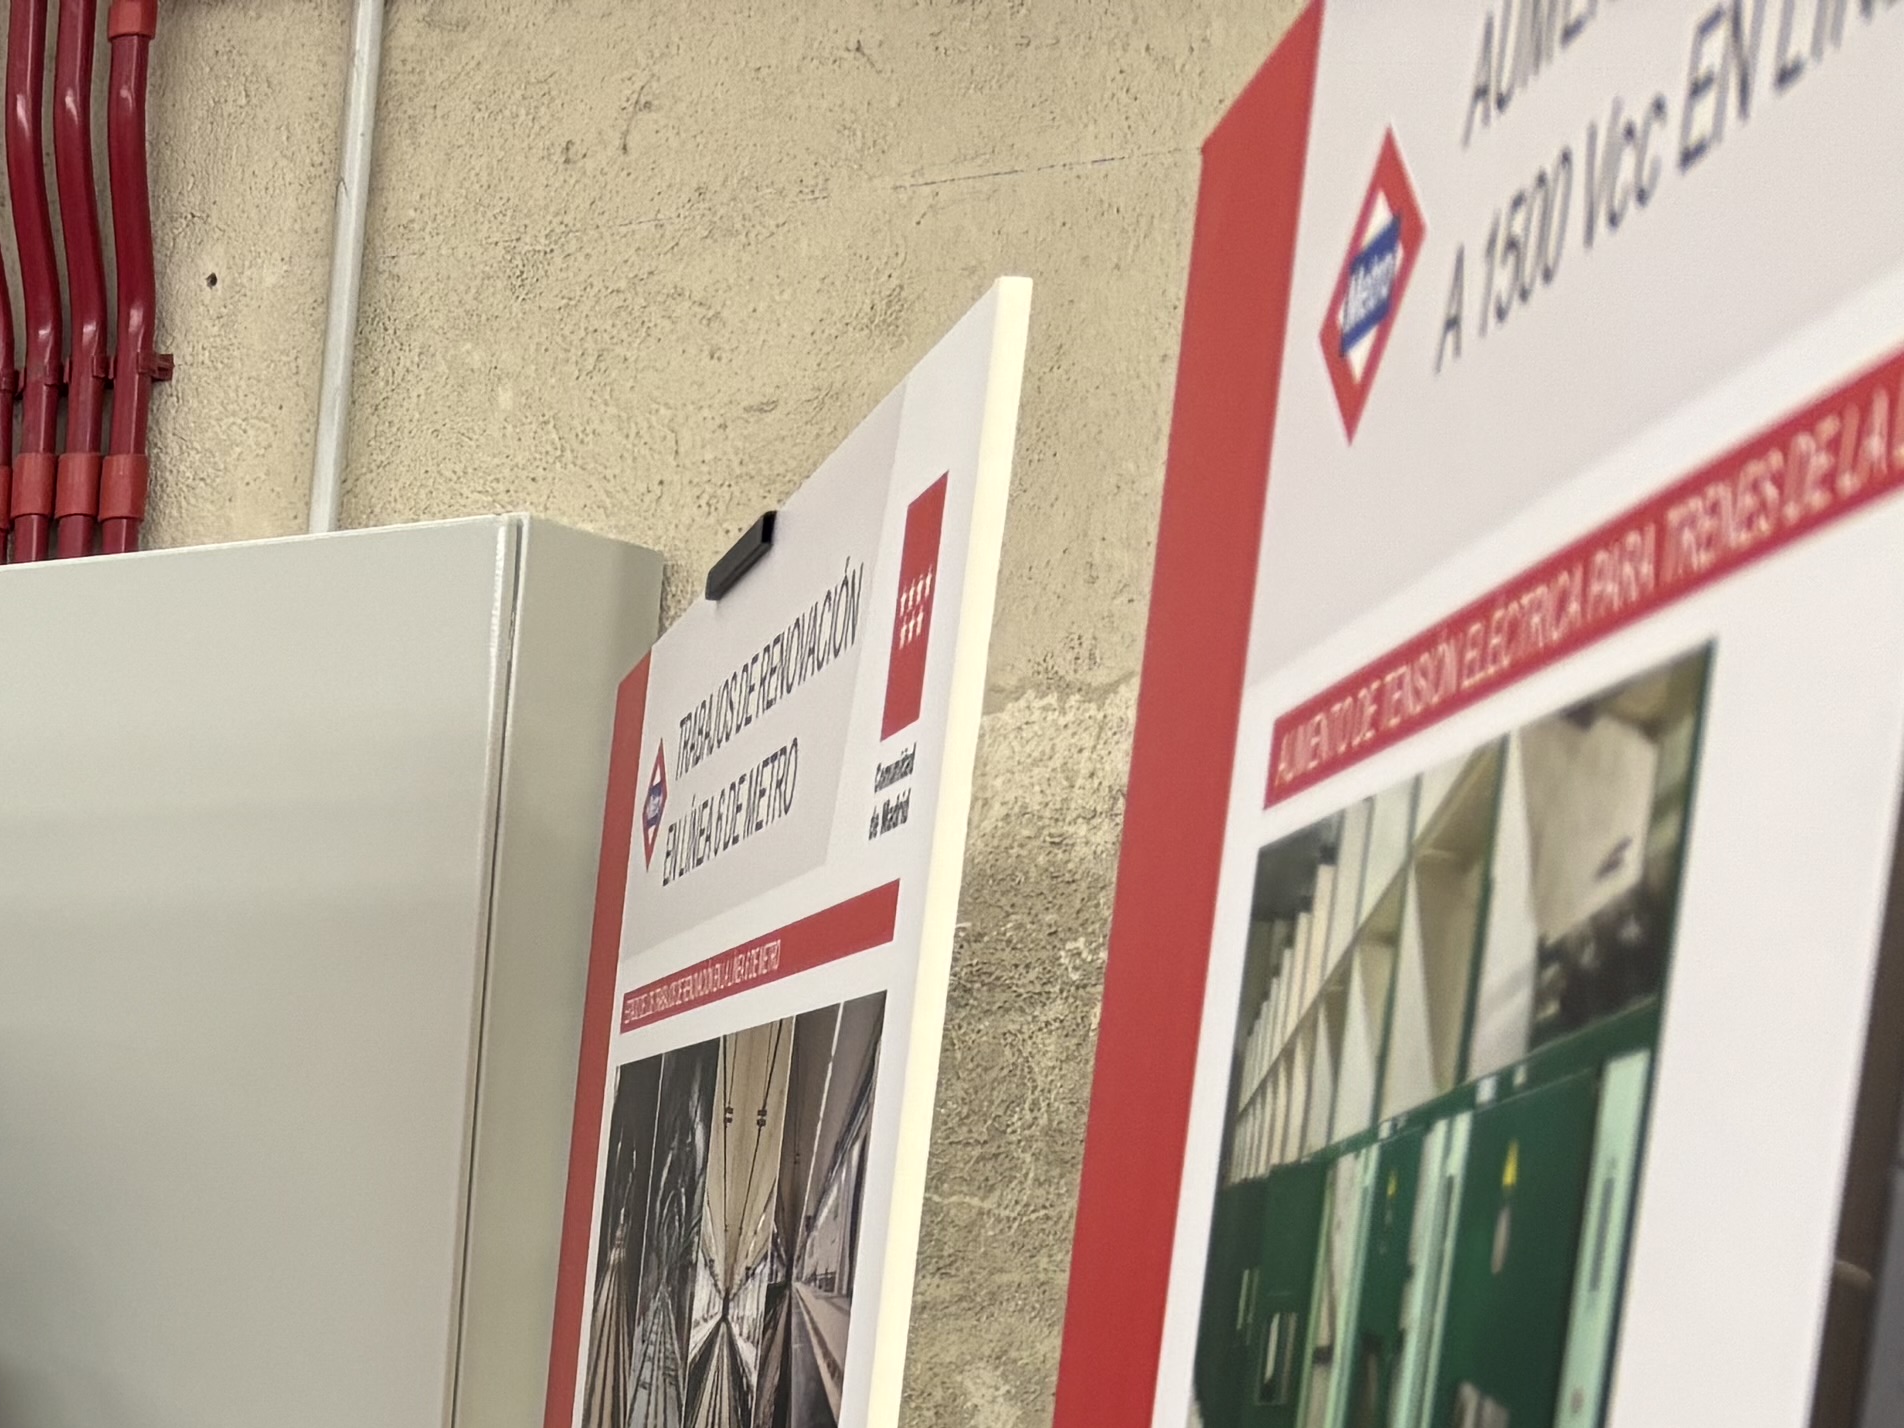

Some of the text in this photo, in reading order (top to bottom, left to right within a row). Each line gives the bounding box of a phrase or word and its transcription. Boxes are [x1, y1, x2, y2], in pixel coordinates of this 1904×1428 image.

[1343, 243, 1398, 330] Metro
[1435, 243, 1464, 374] A
[1479, 146, 1573, 338] 1500
[1583, 94, 1667, 250] Vcc
[1278, 696, 1352, 782] AUMENTO
[1352, 680, 1382, 746] DE
[1382, 640, 1458, 728] TENSIÓN
[1462, 566, 1582, 690] ELÉCTRICA
[1590, 526, 1654, 610] PARA
[1668, 450, 1784, 570] TRENES
[1782, 416, 1840, 522] DE
[1836, 386, 1890, 492] LA
[674, 556, 864, 782] TRABAJOS DE RENOVACIÓN
[662, 736, 798, 886] EN LÍNEA 6 DE METRO
[868, 788, 912, 840] de Madrid
[874, 742, 916, 794] Comunidad
[758, 940, 780, 974] METRO
